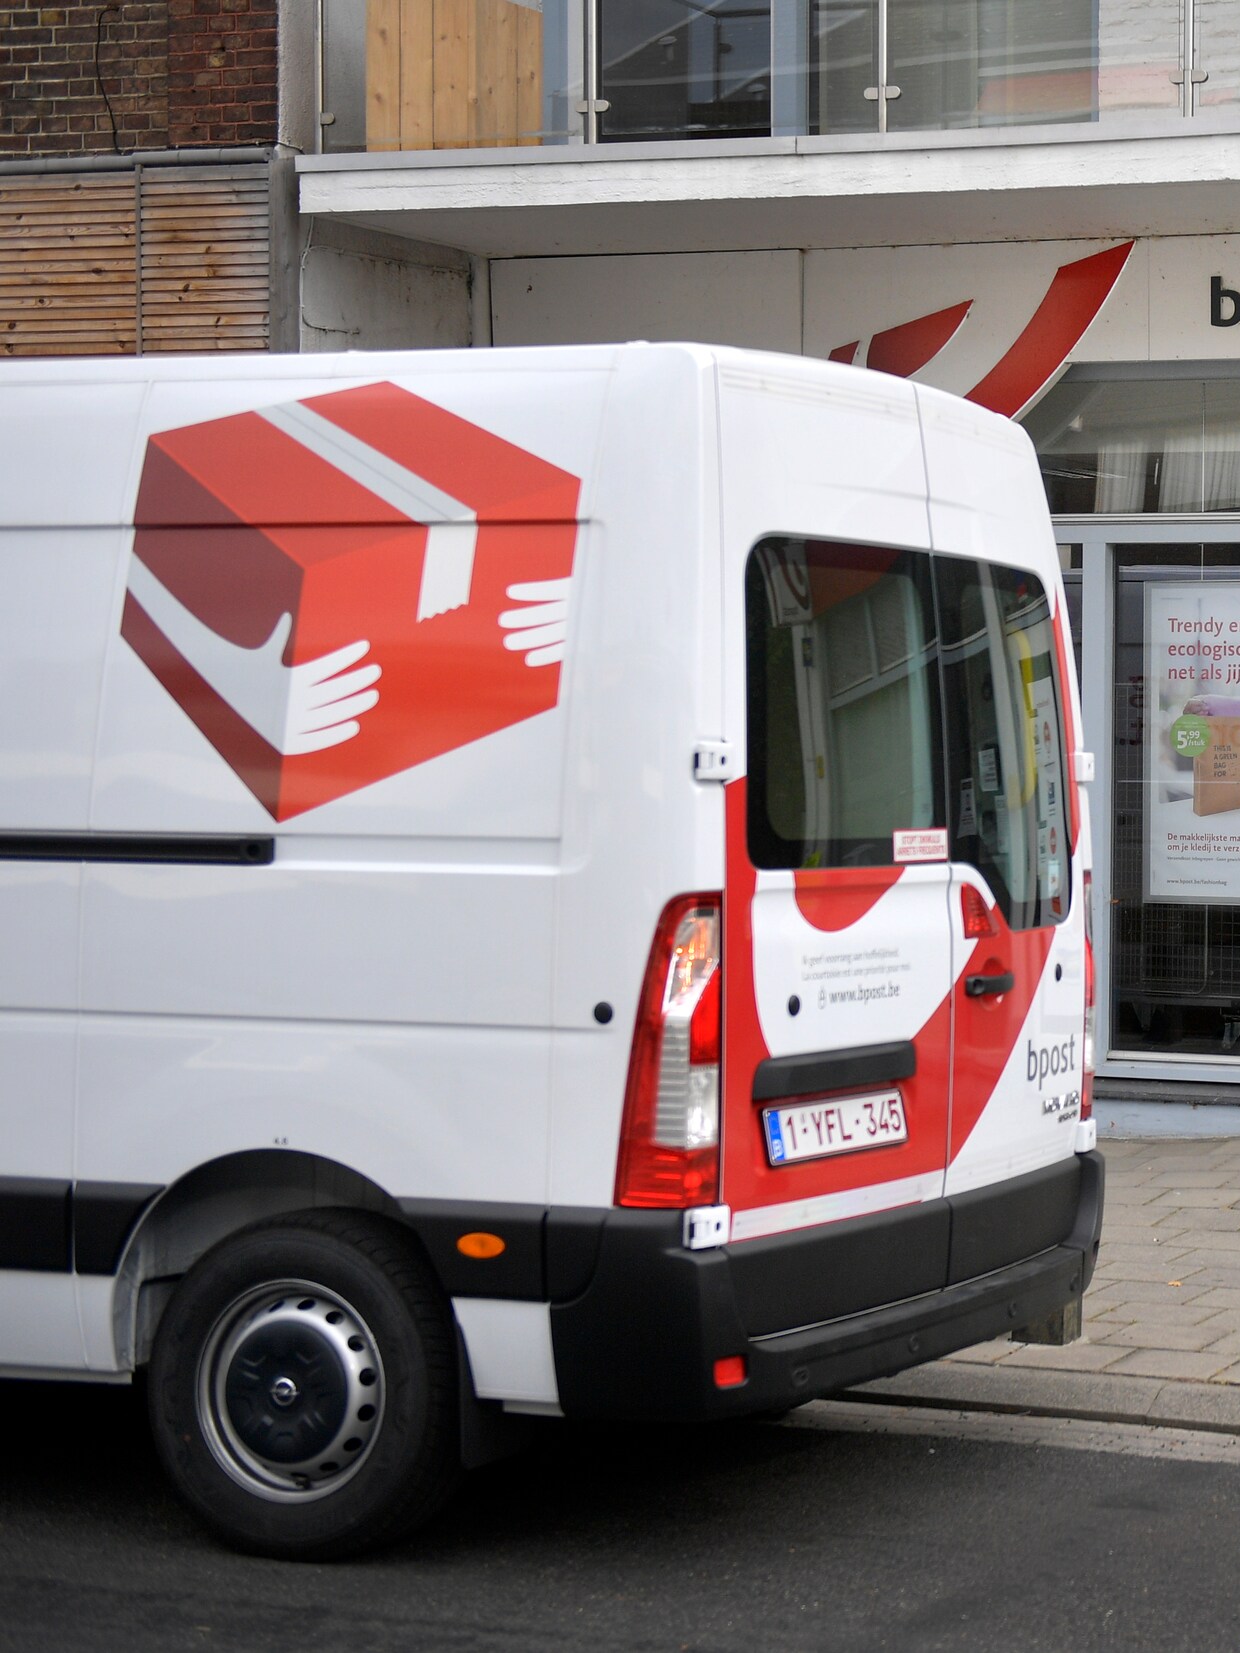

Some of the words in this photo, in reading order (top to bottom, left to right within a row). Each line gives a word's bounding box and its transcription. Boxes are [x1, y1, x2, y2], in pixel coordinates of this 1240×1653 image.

[1168, 616, 1223, 638] Trendy
[1168, 666, 1195, 680] net
[1200, 663, 1222, 680] als
[1176, 730, 1200, 749] 5,99
[1167, 832, 1178, 840] De
[1180, 832, 1228, 843] makkelijkste
[1181, 844, 1189, 853] je
[1190, 843, 1212, 853] kledij
[829, 981, 900, 1005] www.bpost.be
[1027, 1034, 1075, 1091] bpost
